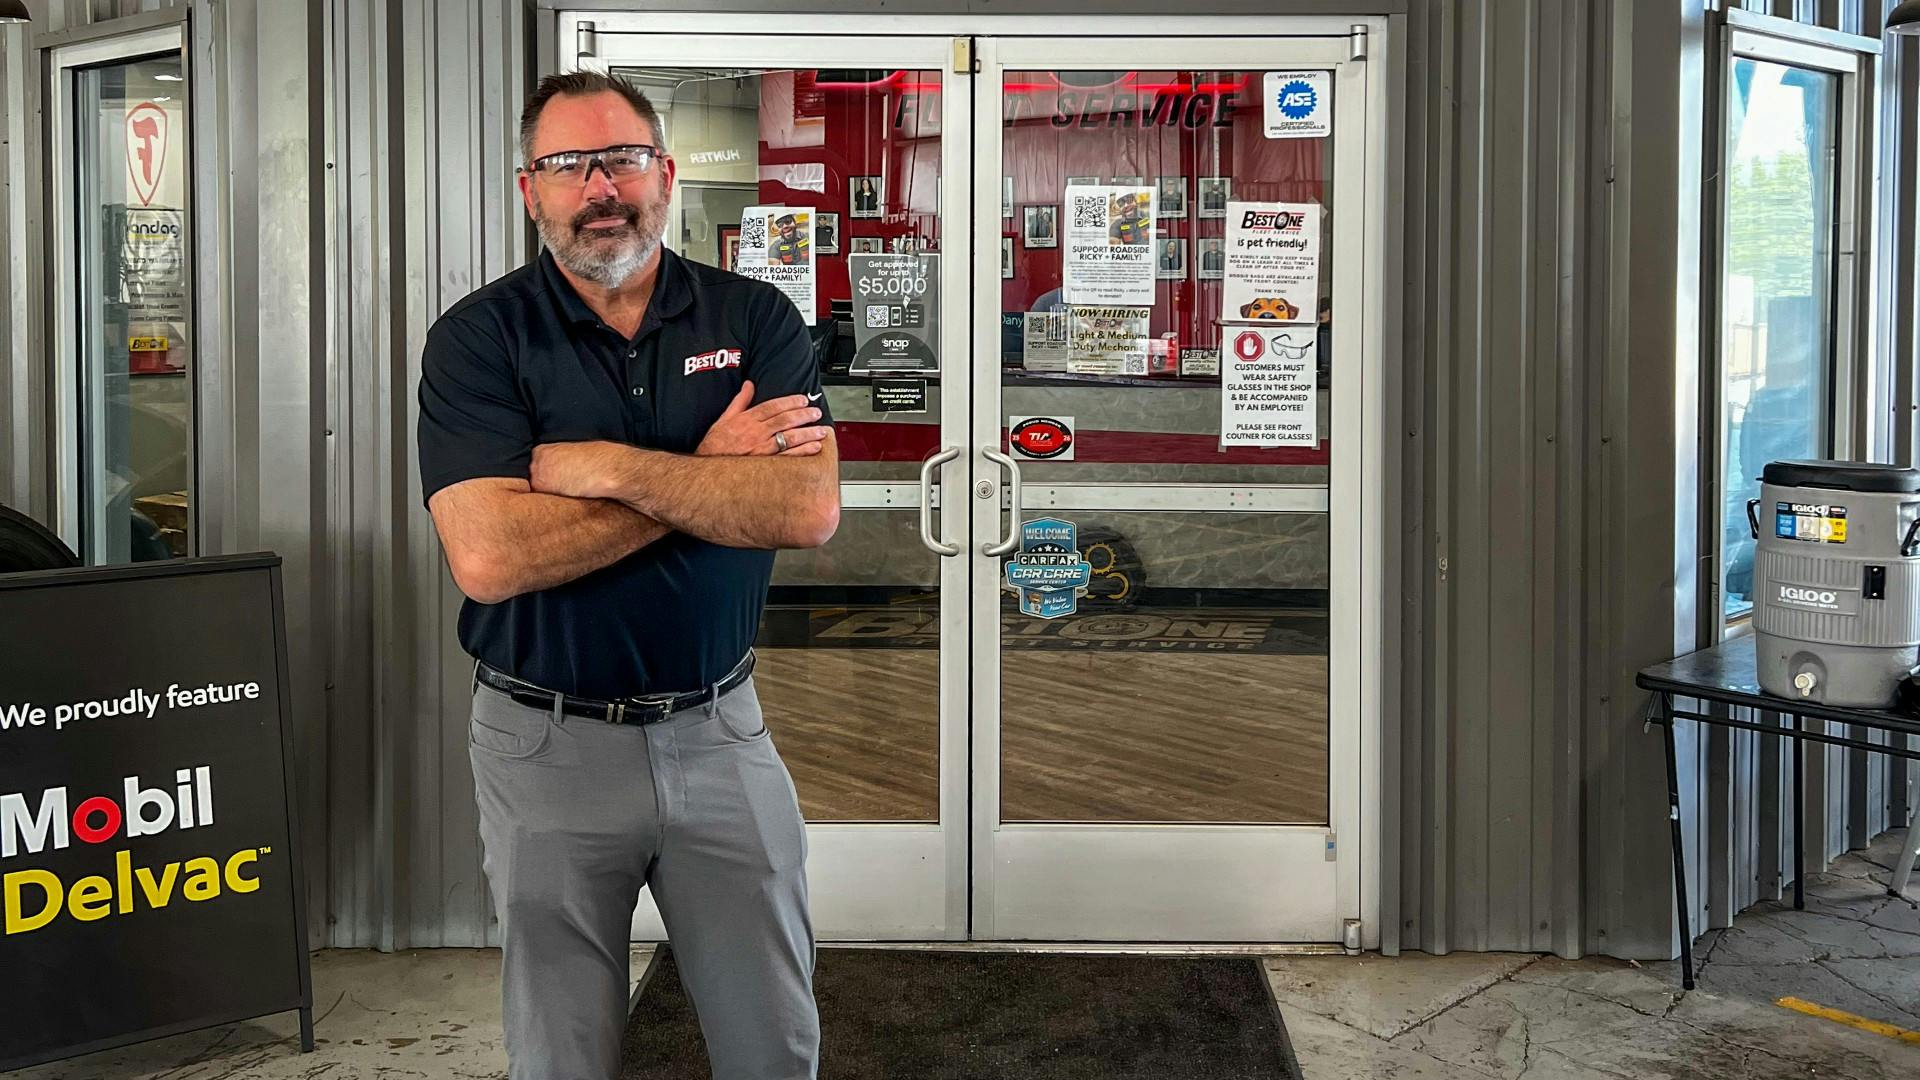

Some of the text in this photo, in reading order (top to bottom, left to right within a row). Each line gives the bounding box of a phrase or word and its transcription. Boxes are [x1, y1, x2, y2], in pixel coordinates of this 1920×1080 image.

[1282, 92, 1312, 107] ASE
[1051, 92, 1241, 129] SERVICE
[1237, 237, 1308, 251] is pet friendly!
[1110, 246, 1150, 254] ROADSIDE
[1079, 253, 1105, 261] RICKY
[1111, 253, 1142, 261] FAMILY!
[884, 261, 919, 270] approved
[771, 274, 802, 282] FAMILY!
[890, 270, 900, 278] up
[1070, 308, 1149, 319] NOW HIRING
[1097, 331, 1105, 339] &
[1107, 331, 1148, 340] Medium
[1073, 342, 1095, 352] Duty
[1277, 433, 1313, 441] GLASSES!
[1792, 504, 1824, 514] IGLOO
[1025, 527, 1072, 540] WELCOME
[1020, 556, 1077, 566] CARFAX
[1013, 568, 1083, 578] CAR CARE
[1780, 586, 1836, 604] IGLOO
[1071, 639, 1256, 649] SERVICE
[0, 681, 260, 730] We proudly feature
[0, 766, 214, 858] Mobil
[3, 849, 260, 935] Delvac
